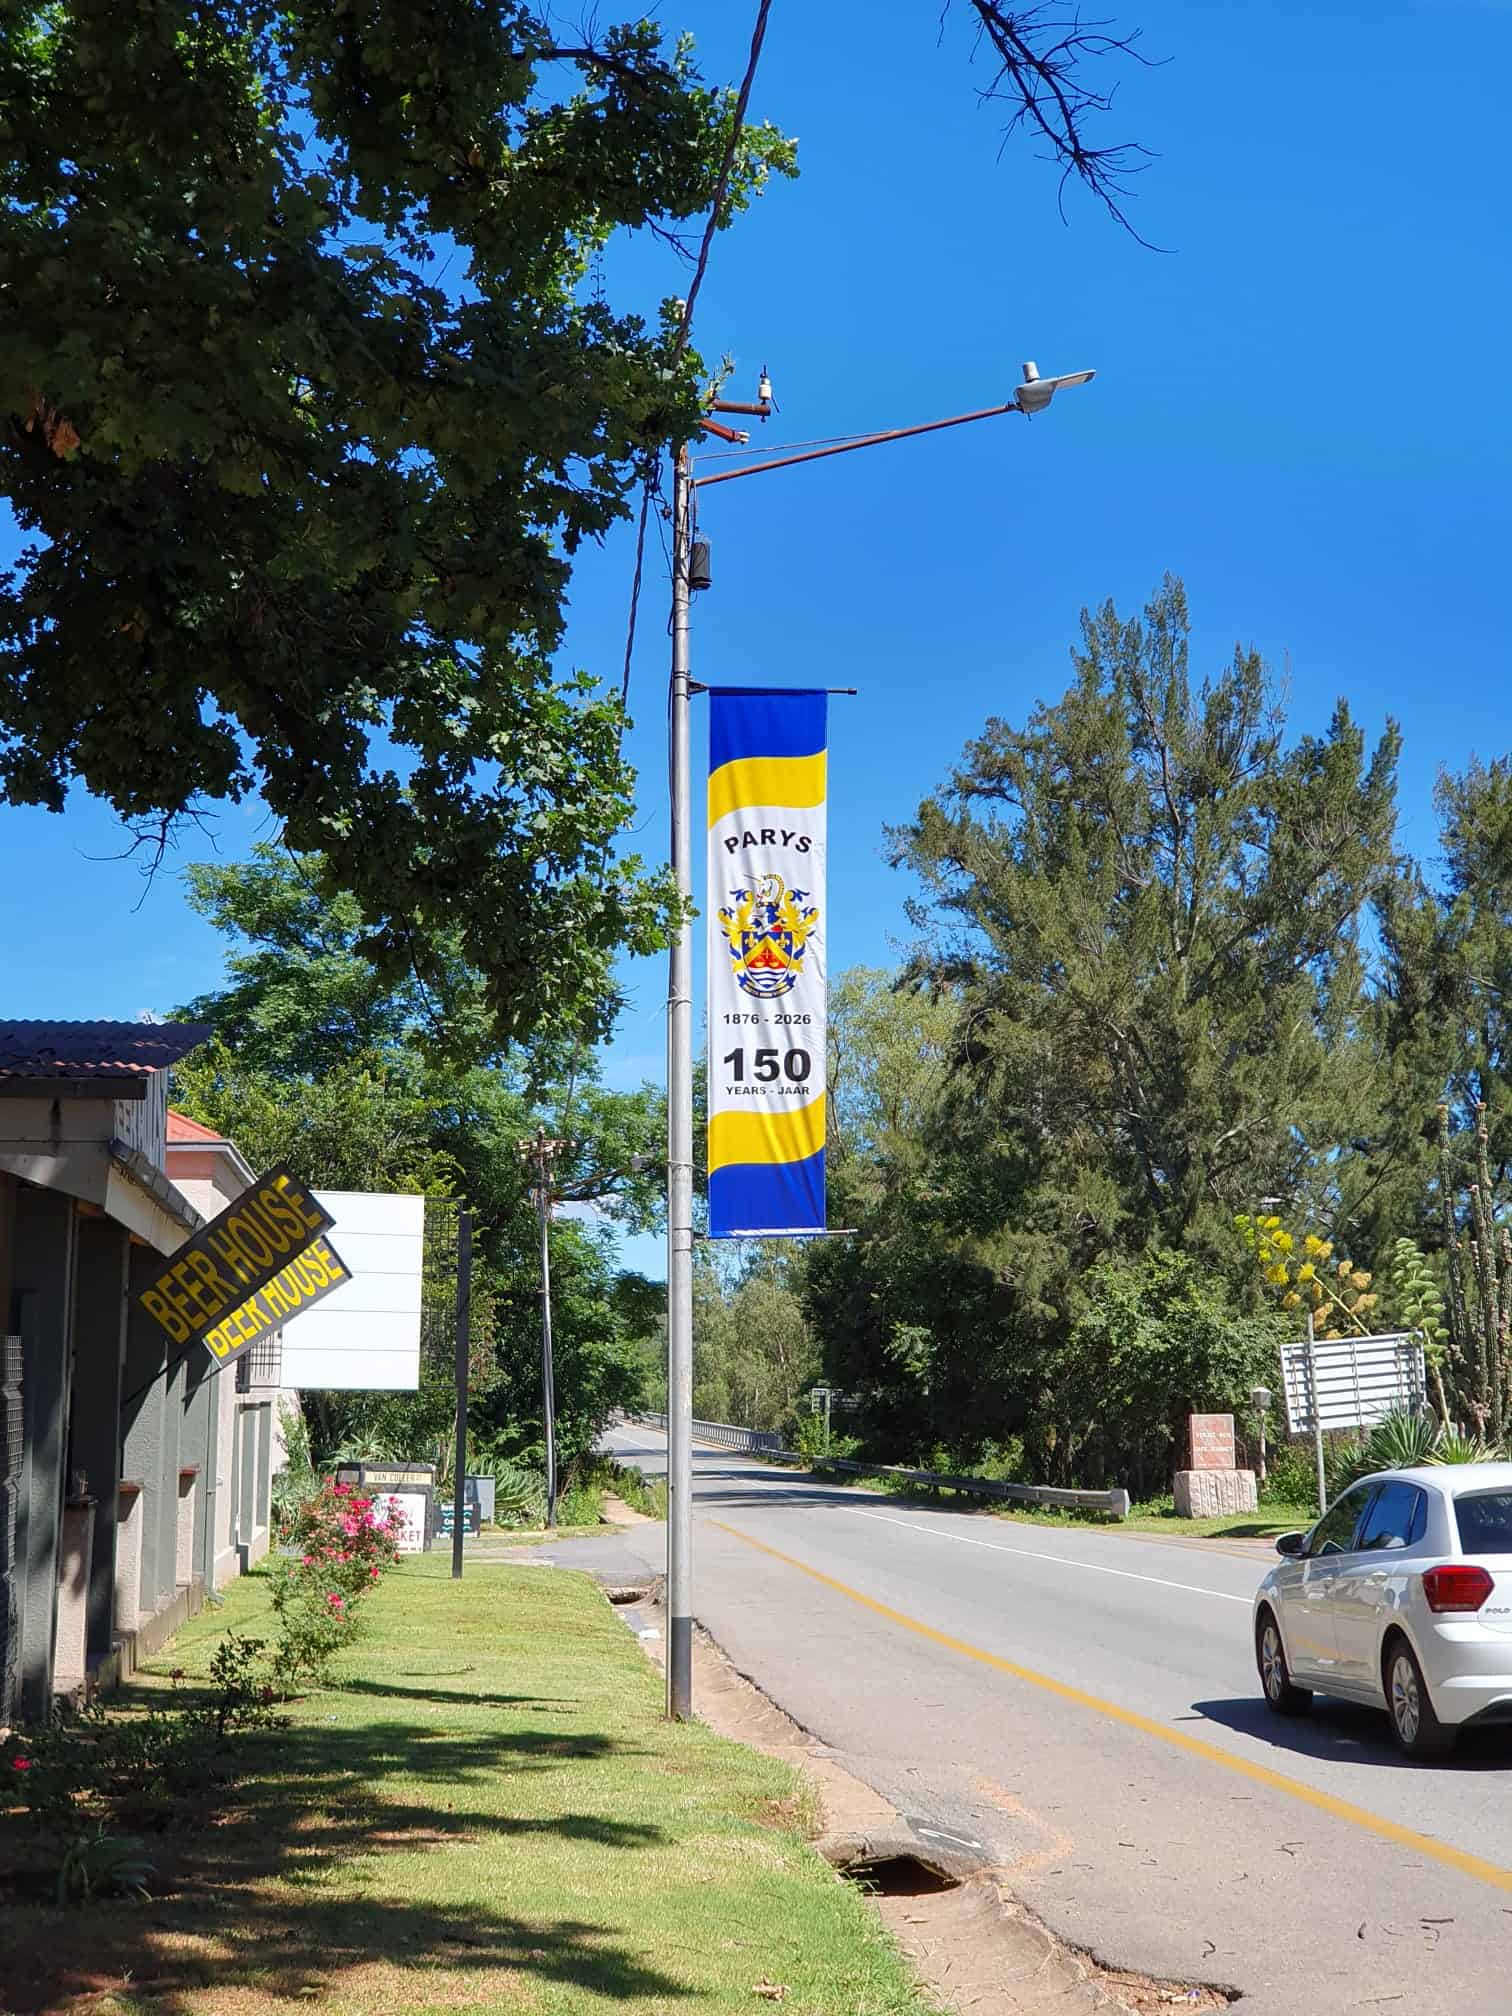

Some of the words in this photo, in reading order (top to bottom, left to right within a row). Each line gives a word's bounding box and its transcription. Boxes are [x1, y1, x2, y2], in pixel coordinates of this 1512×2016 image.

[724, 829, 812, 854] PARYS
[724, 1013, 760, 1025] 1876
[774, 1013, 812, 1025] 2026
[723, 1047, 812, 1082] 150
[726, 1086, 766, 1095] YEARS
[778, 1086, 810, 1095] JAAR
[139, 1250, 241, 1344] BEER
[207, 1175, 323, 1285] HOUSE
[259, 1238, 345, 1318] HOUSE
